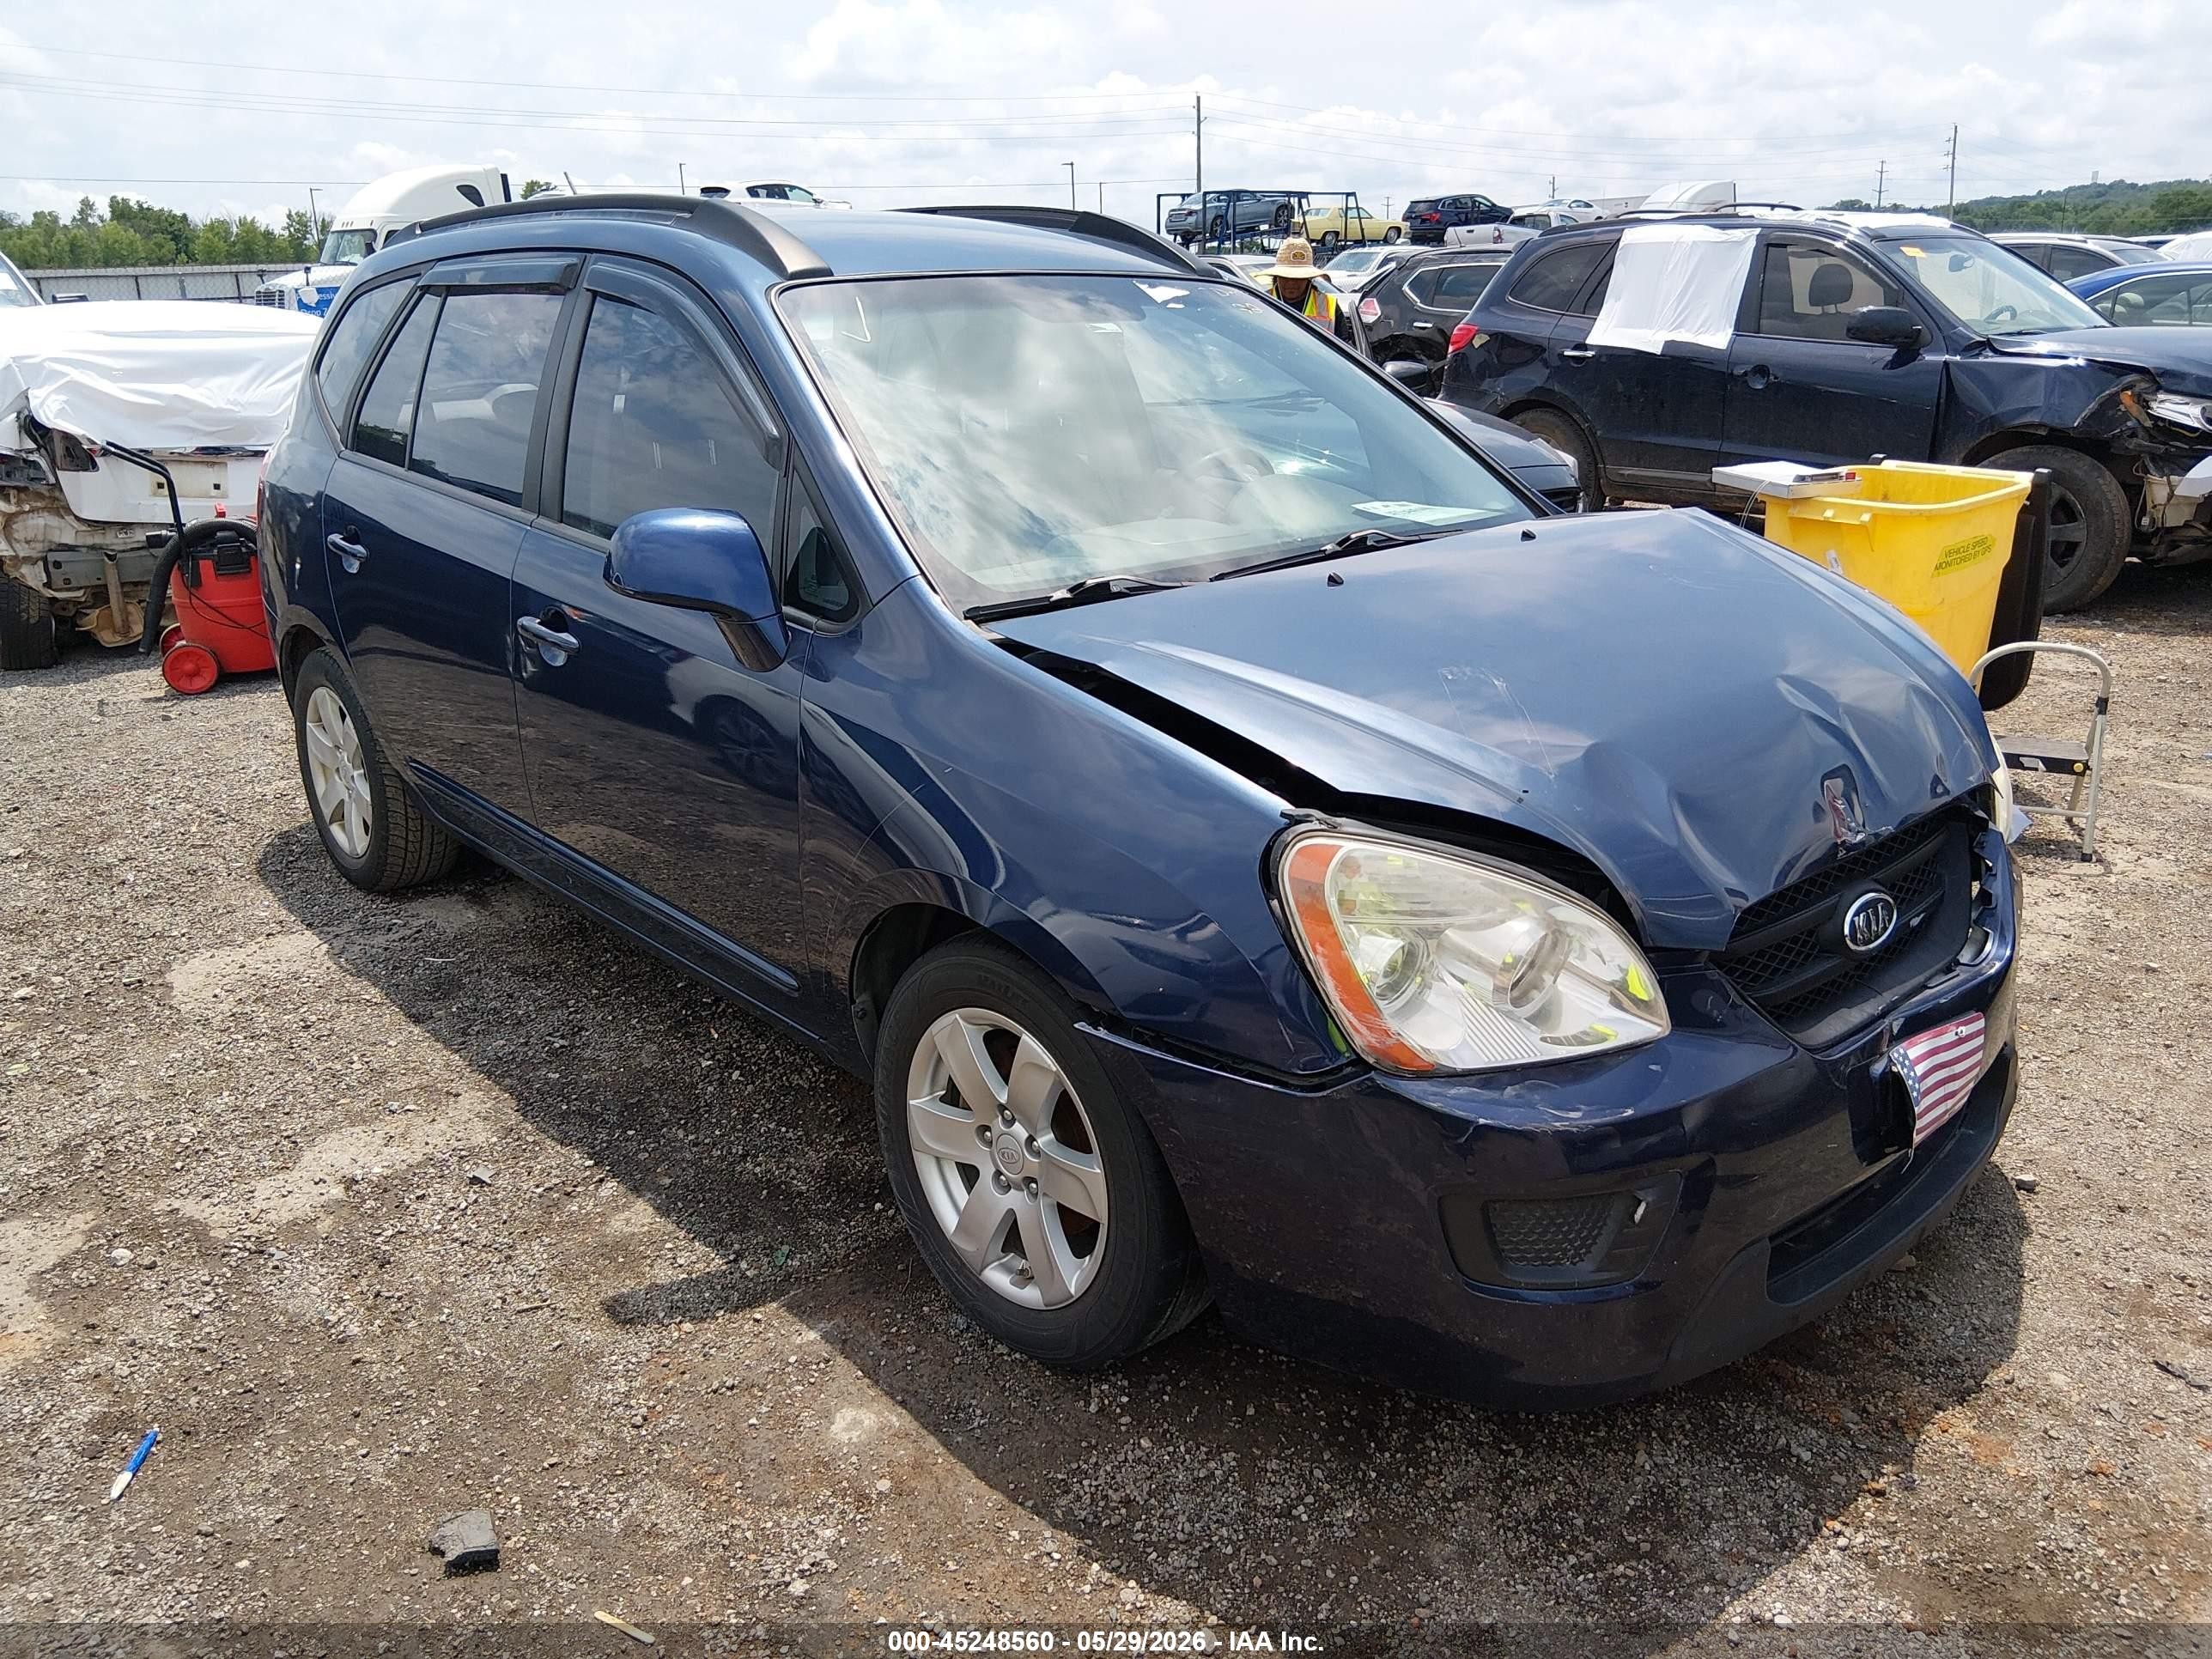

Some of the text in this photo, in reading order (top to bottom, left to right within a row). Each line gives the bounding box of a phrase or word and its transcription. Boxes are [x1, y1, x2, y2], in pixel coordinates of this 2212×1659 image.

[1934, 544, 1992, 572] MONITORED BY GPS
[1944, 536, 1989, 559] VEHICLE SPEED
[1853, 902, 1889, 946] KIA
[1000, 1151, 1017, 1162] KIA
